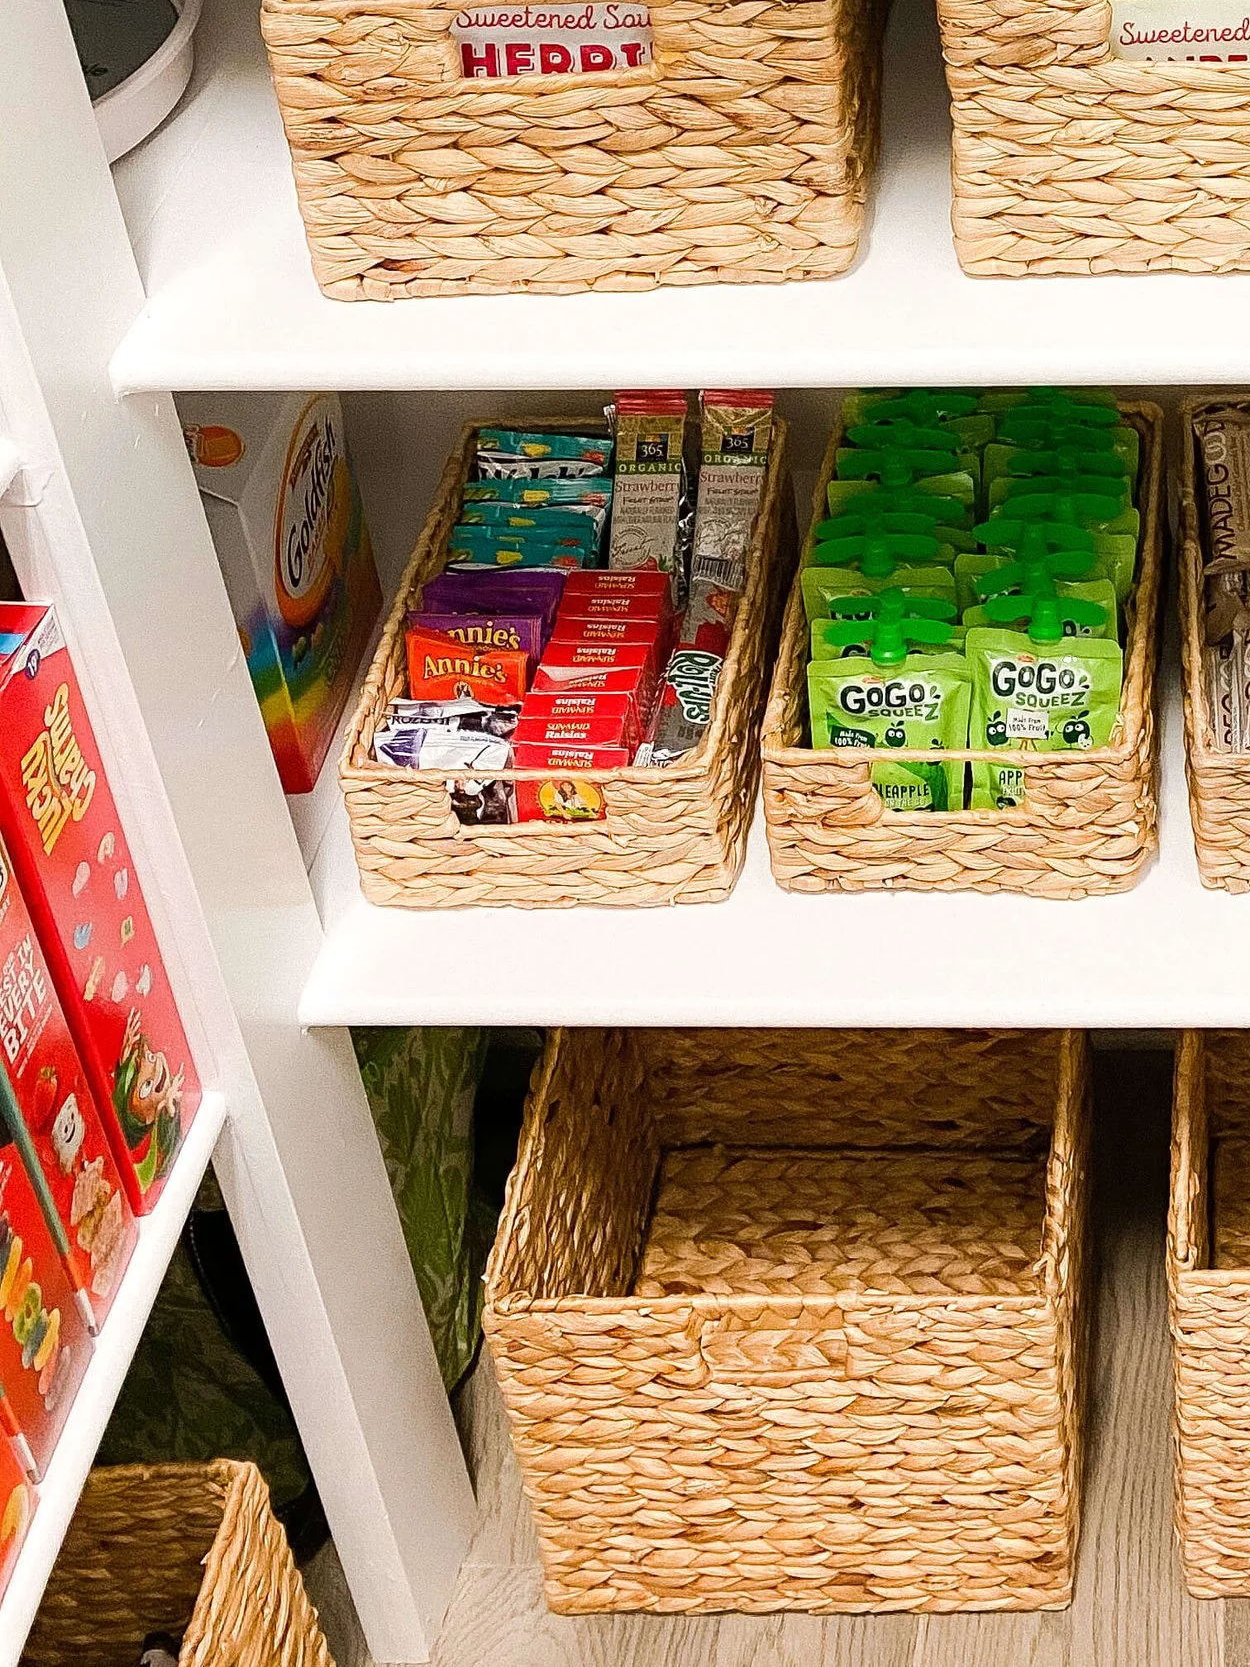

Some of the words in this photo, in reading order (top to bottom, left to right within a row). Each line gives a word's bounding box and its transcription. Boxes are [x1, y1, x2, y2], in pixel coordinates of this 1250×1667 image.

[456, 5, 598, 30] Sweetened
[725, 437, 748, 449] 365
[641, 444, 664, 458] 365
[618, 463, 681, 473] ORGANIC
[287, 415, 338, 589] Goldfish
[447, 620, 521, 650] nnie's
[423, 655, 507, 684] Annie's
[555, 698, 596, 706] Raisins
[544, 730, 587, 739] Raisins
[551, 748, 594, 758] Raisins
[3, 968, 47, 1065] BITE
